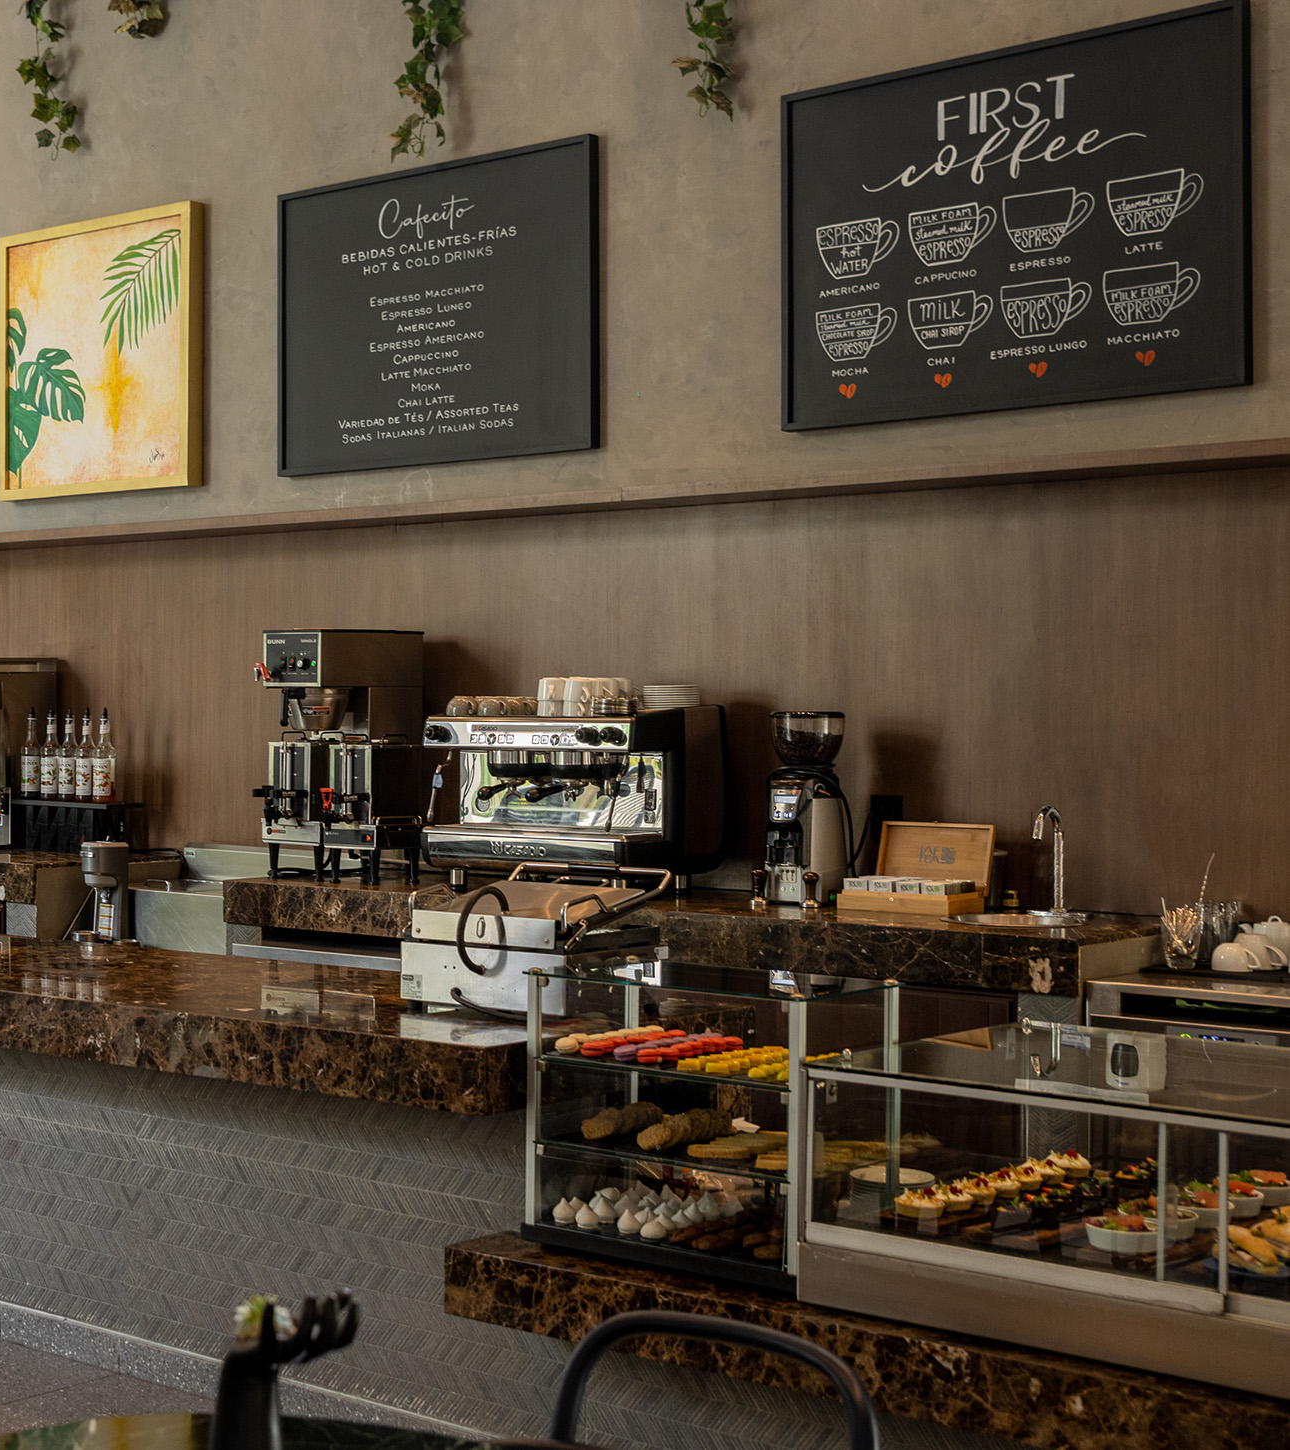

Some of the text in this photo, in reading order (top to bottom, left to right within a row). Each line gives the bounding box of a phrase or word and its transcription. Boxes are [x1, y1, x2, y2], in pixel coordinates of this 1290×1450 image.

[937, 73, 1076, 142] FIRST
[862, 118, 1148, 193] coffee
[378, 194, 476, 239] Cafecito
[342, 226, 518, 263] BEBIDAS CALIENTES-FRÍAS
[1125, 241, 1163, 254] LATTE
[363, 246, 493, 275] HOT & COLD DRINKS
[831, 259, 868, 274] WATER
[1010, 256, 1071, 271] ESPRESSO
[915, 269, 977, 285] CAPPUCINO
[819, 283, 880, 298] AMERICANO
[1107, 329, 1180, 345] MACCHIATO
[990, 340, 1087, 360] ESPRESSO LUNGO
[927, 357, 955, 366] CHAI
[832, 367, 869, 377] MOCHA
